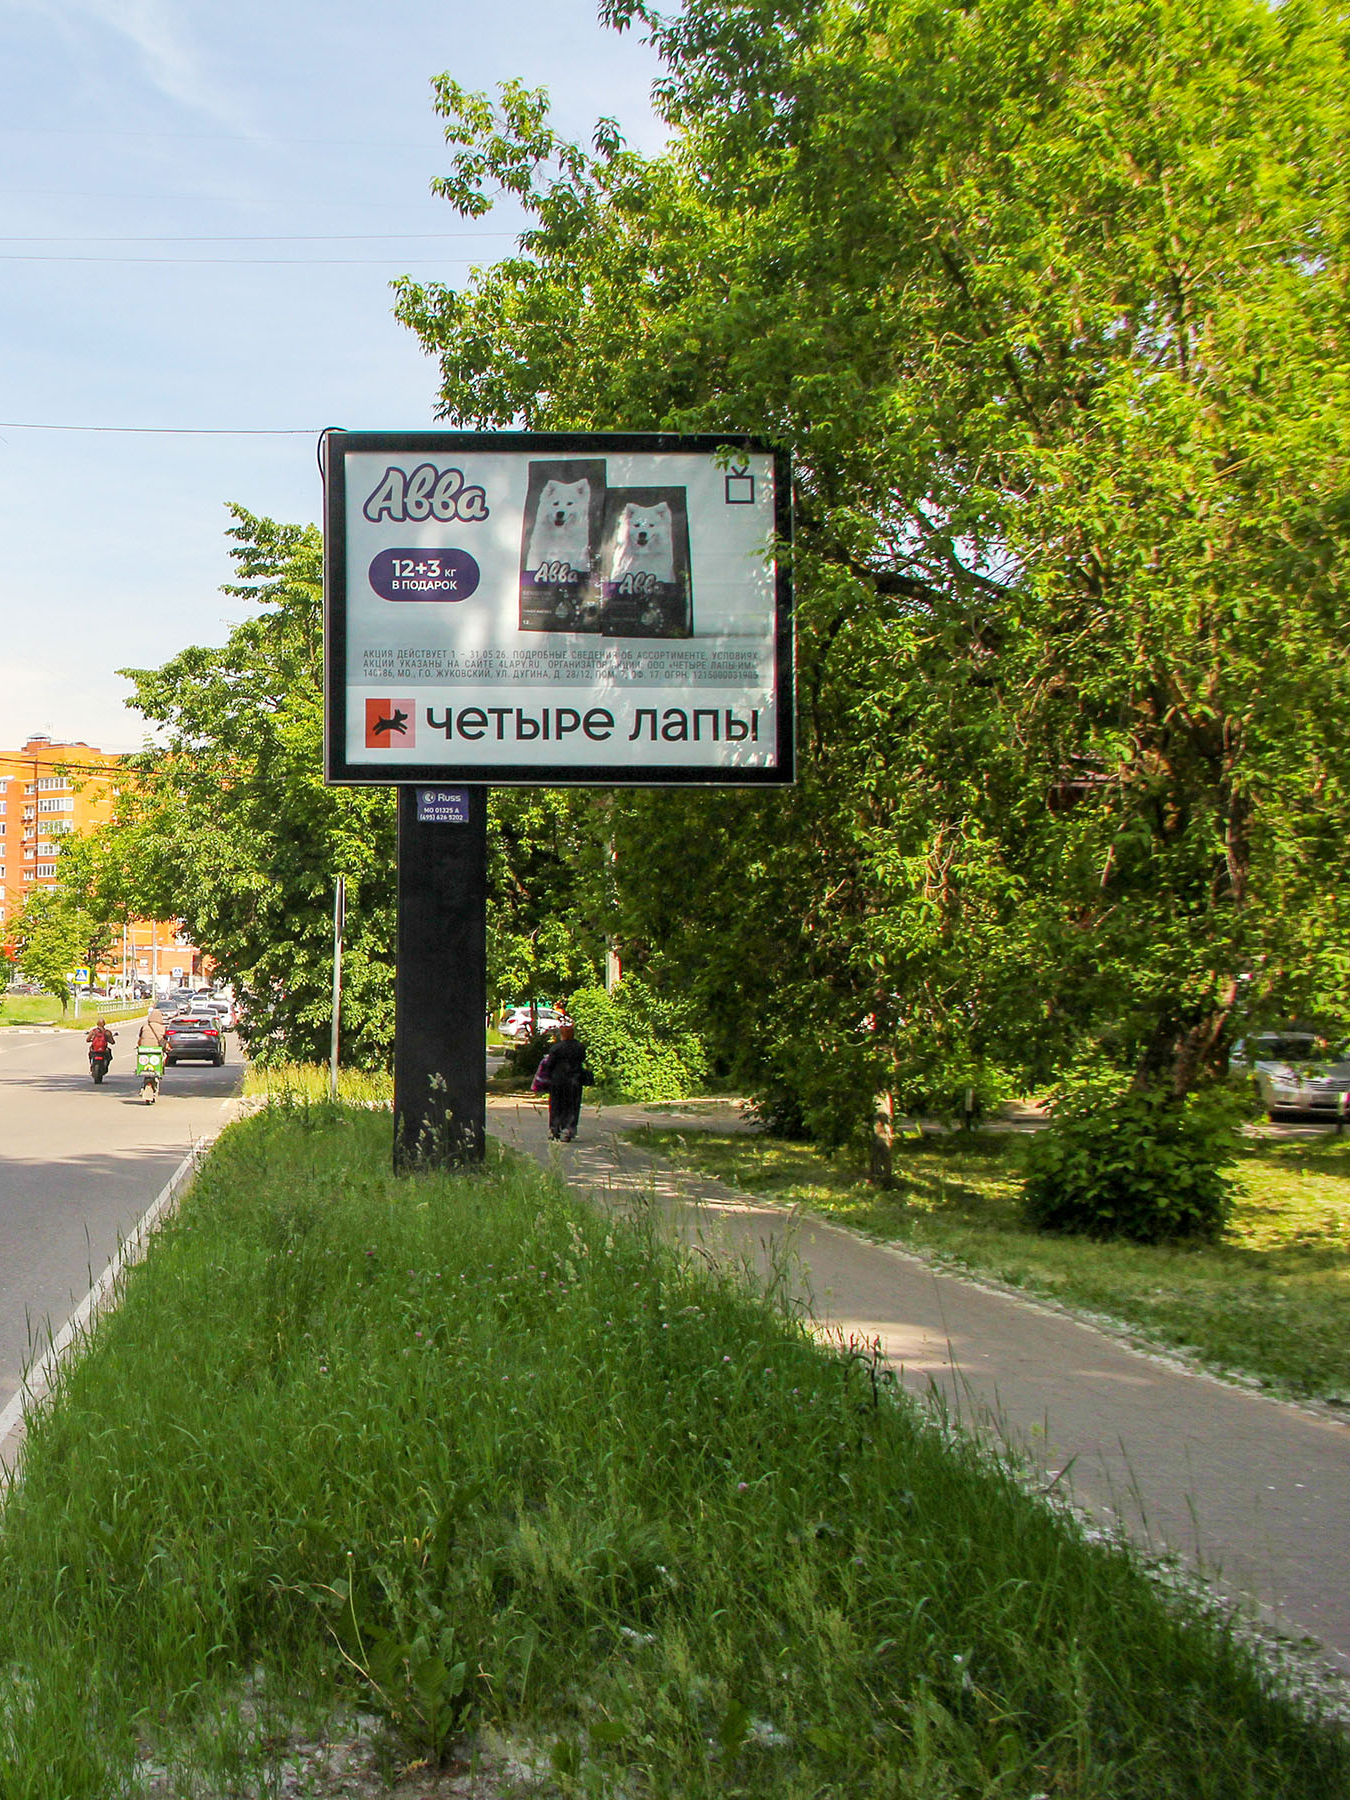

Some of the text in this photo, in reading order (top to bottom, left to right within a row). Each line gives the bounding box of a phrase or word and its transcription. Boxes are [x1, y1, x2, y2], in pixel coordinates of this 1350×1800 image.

[392, 559, 441, 577] 12+3
[392, 580, 458, 591] В ПОДАРОК
[363, 649, 393, 660] АКЦИЯ
[397, 649, 447, 660] ДЕЙСТВУЕТ
[451, 650, 455, 659] 1
[513, 650, 567, 660] ПОДРОБНЫЕ
[572, 650, 618, 660] СВЕДЕНИЯ
[622, 651, 633, 660] ОБ
[637, 651, 708, 661] АССОРТИМЕНТЕ,
[712, 651, 758, 660] УСЛОВИЯХ
[363, 660, 394, 669] АКЦИИ
[400, 660, 442, 668] УКАЗАНЫ
[447, 660, 459, 668] НА
[465, 659, 493, 669] САЙТЕ
[548, 661, 608, 669] ОРГАНИЗАТОР
[647, 661, 665, 669] ООО
[669, 661, 706, 670] «ЧЕТЫРЕ
[436, 668, 493, 679] ЖУКОВСКИЙ,
[513, 669, 550, 679] ДУГИНА,
[566, 670, 593, 679] 28/12,
[426, 707, 759, 742] четыре лапы
[438, 793, 461, 802] Russ
